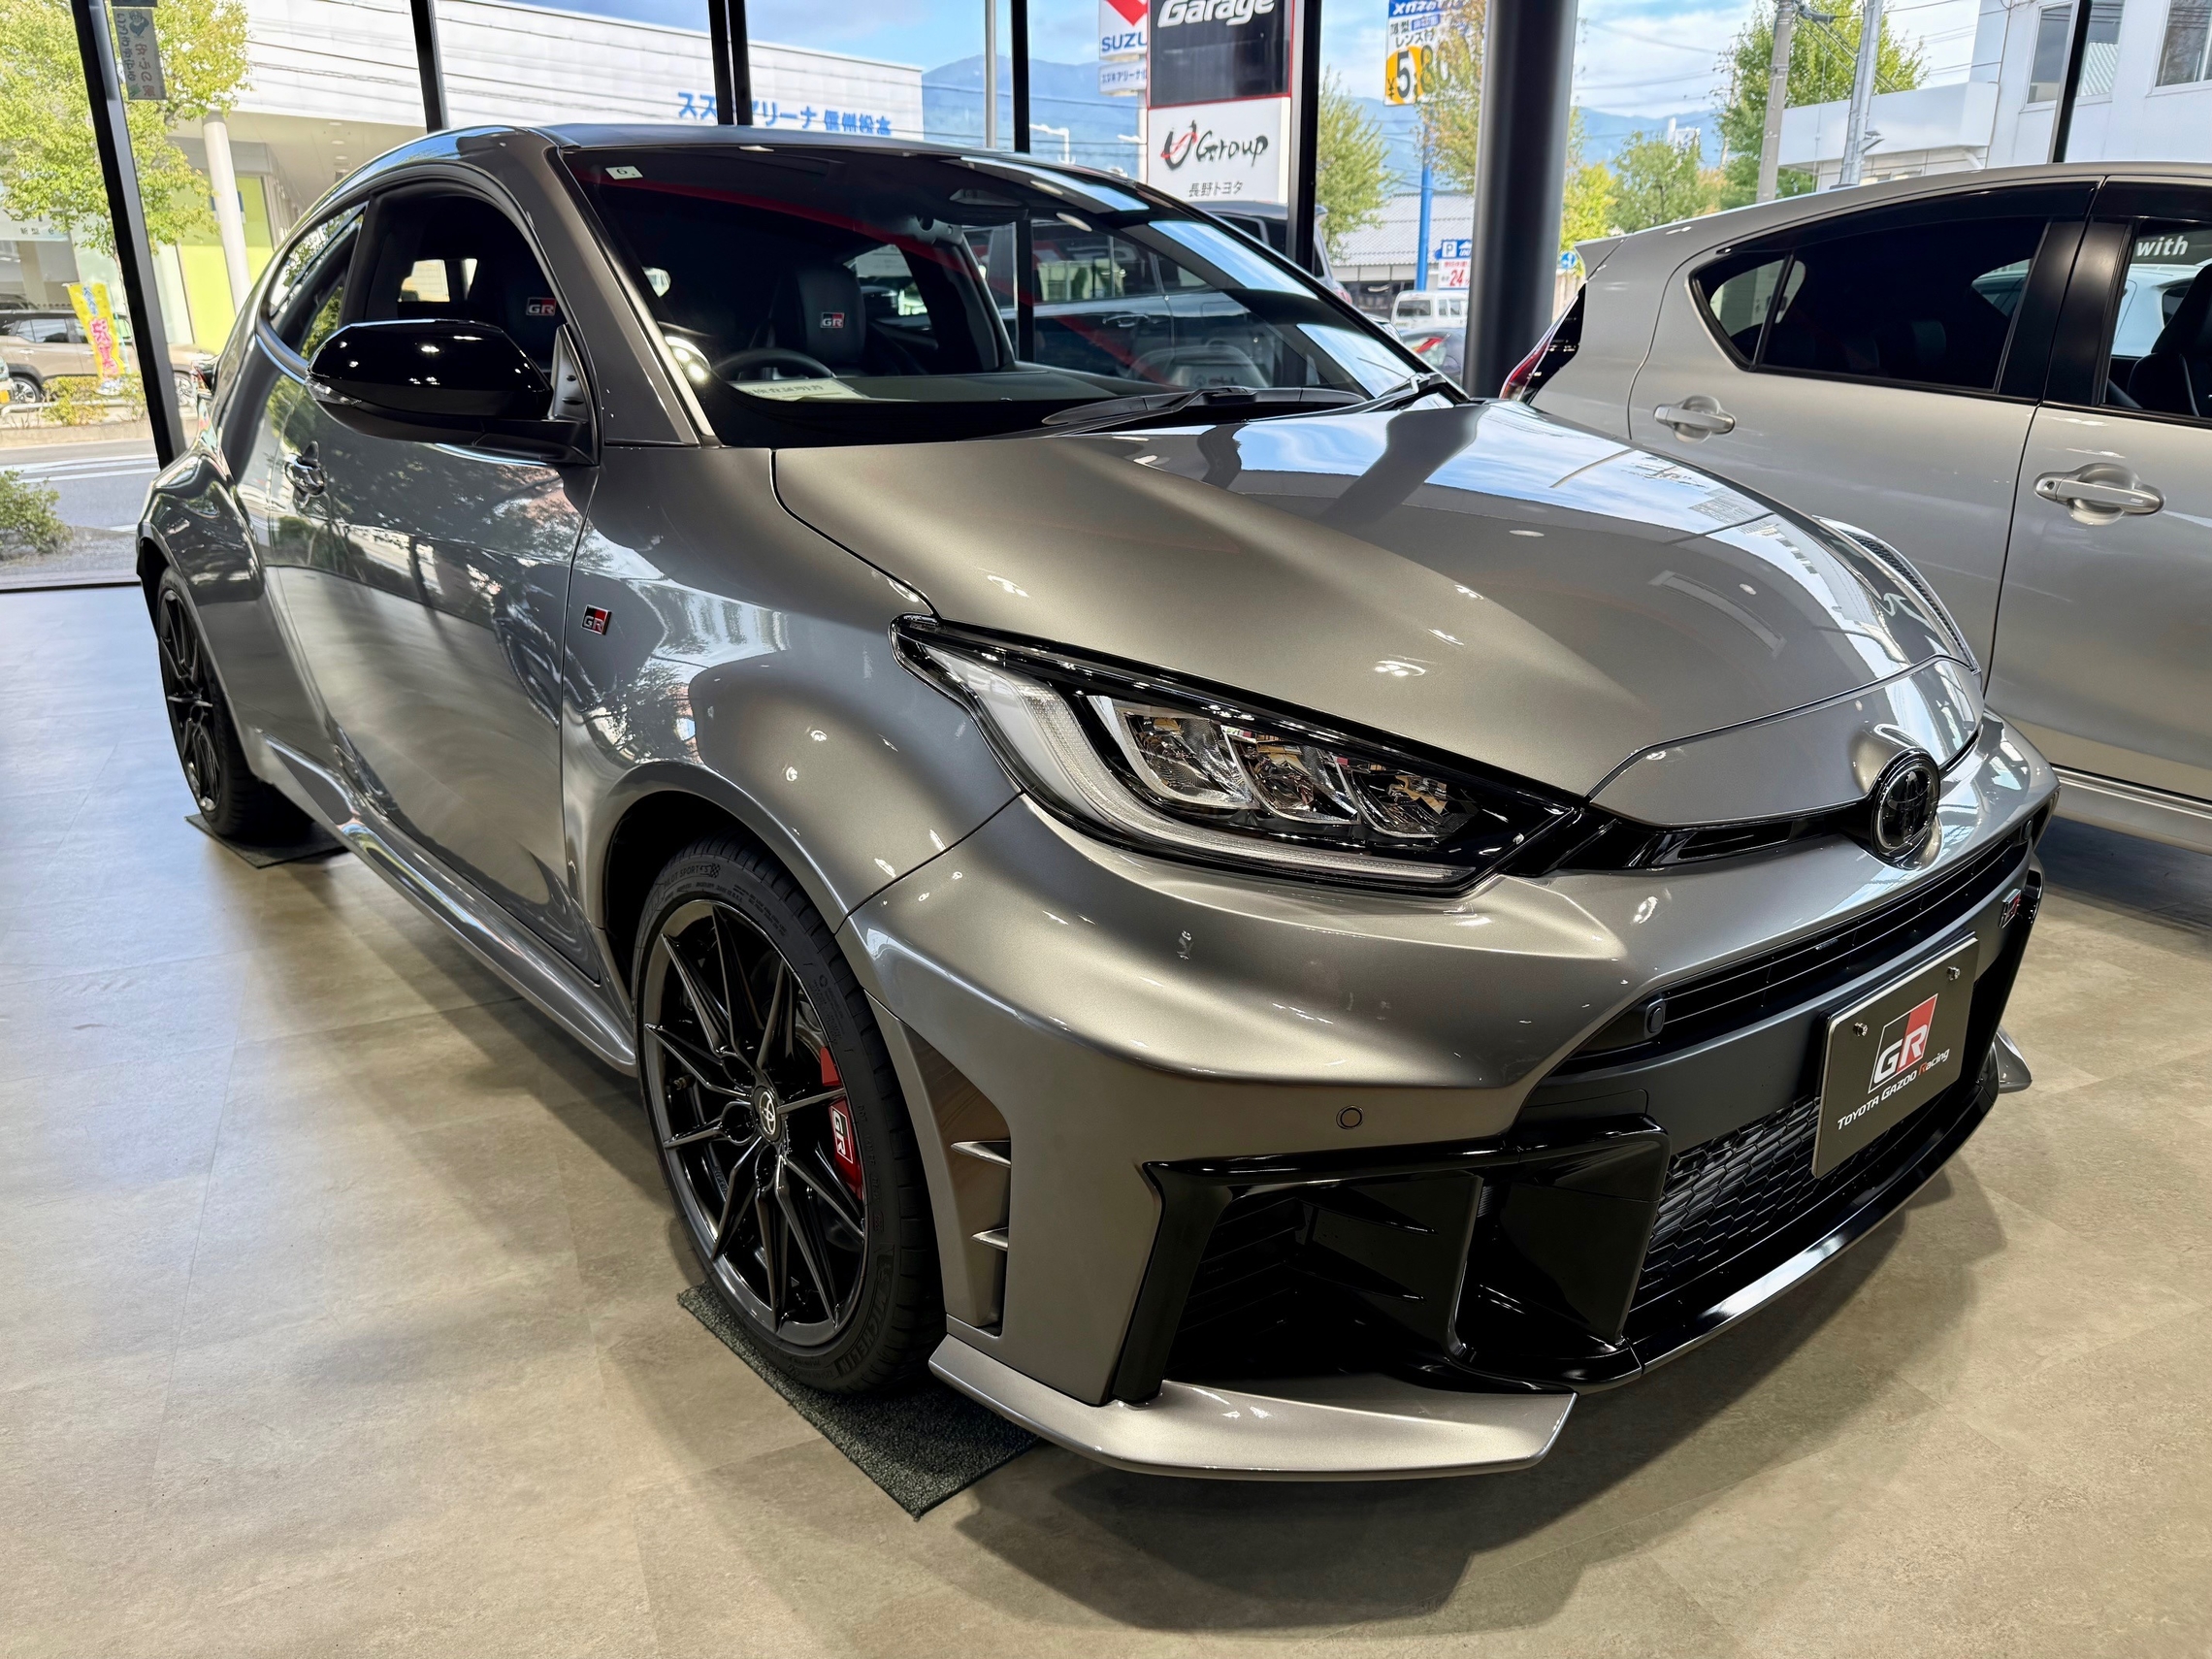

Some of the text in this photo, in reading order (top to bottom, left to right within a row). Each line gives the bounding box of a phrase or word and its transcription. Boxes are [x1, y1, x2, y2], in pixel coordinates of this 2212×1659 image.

[1157, 0, 1275, 28] Garage
[1188, 180, 1244, 197] 長野トヨタ
[2136, 235, 2189, 257] with
[529, 304, 555, 314] GR
[823, 317, 843, 327] GR
[583, 615, 605, 632] GR
[1873, 1024, 1929, 1085] GR
[1837, 1048, 1950, 1130] TOYOTA GAZOO Racing
[832, 1109, 847, 1155] GR
